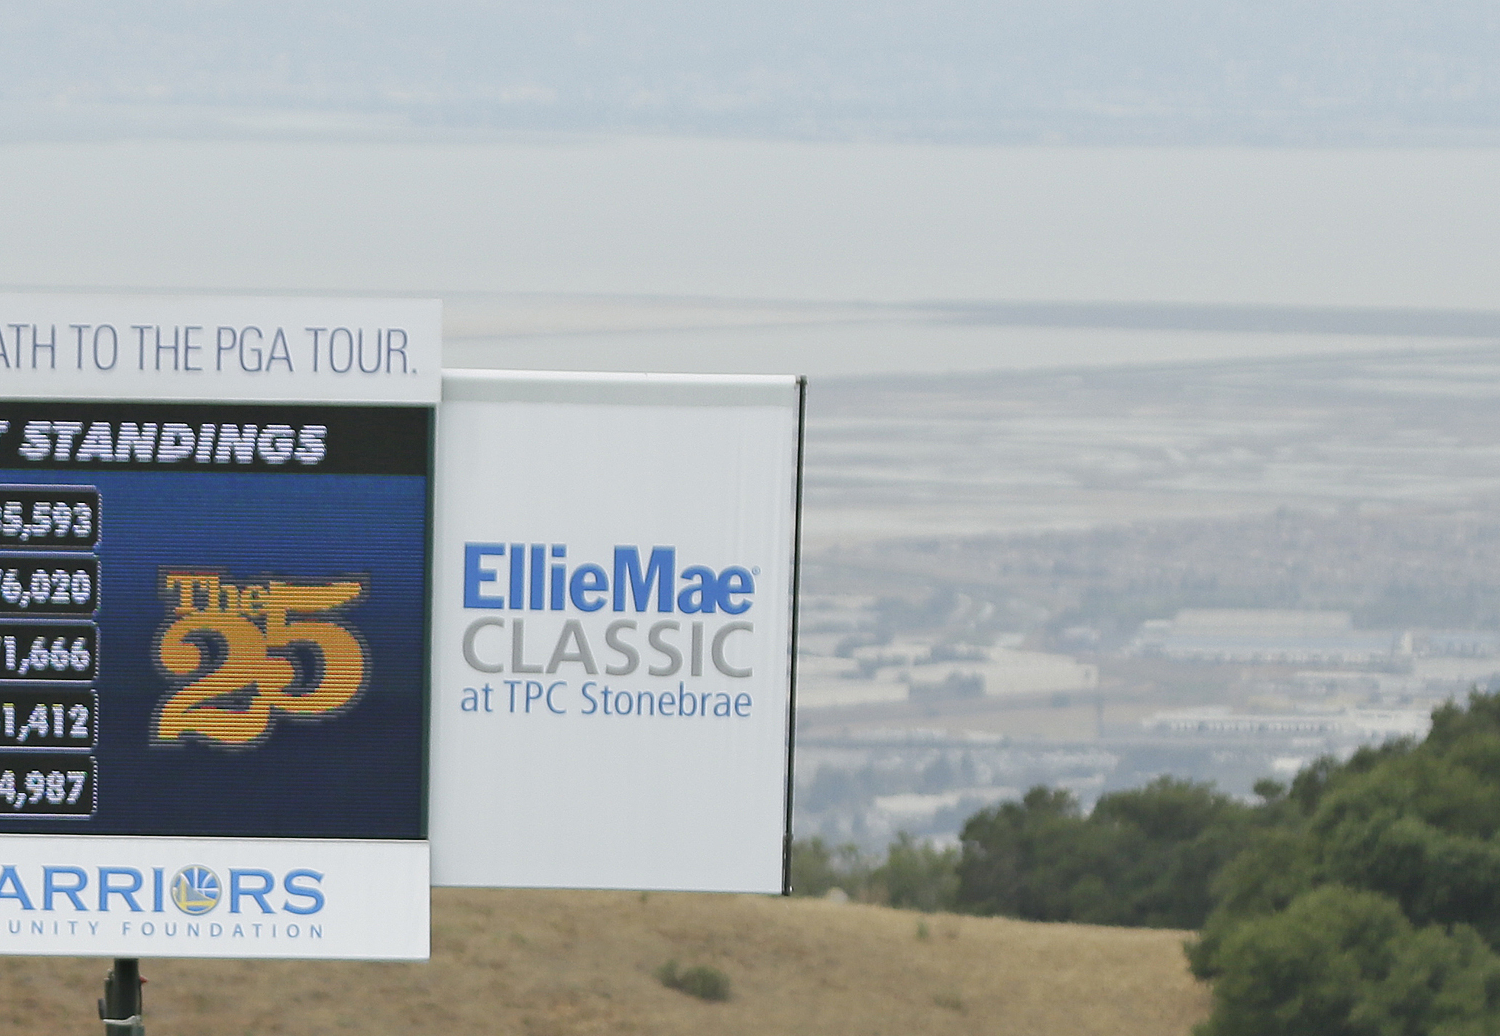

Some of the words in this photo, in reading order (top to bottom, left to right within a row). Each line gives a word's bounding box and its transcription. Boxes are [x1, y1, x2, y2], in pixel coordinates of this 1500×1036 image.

[69, 324, 118, 370] TO
[131, 325, 202, 372] THE
[216, 325, 294, 374] PGA
[305, 327, 418, 375] TOUR.
[18, 420, 328, 465] STANDINGS
[166, 572, 272, 616] The
[463, 541, 755, 615] EllieMae
[156, 581, 367, 745] 25
[462, 616, 754, 678] CLASSIC
[460, 683, 494, 713] at
[503, 680, 567, 714] TPC
[581, 681, 752, 717] Stonebrae
[122, 920, 323, 939] FOUNDATION
